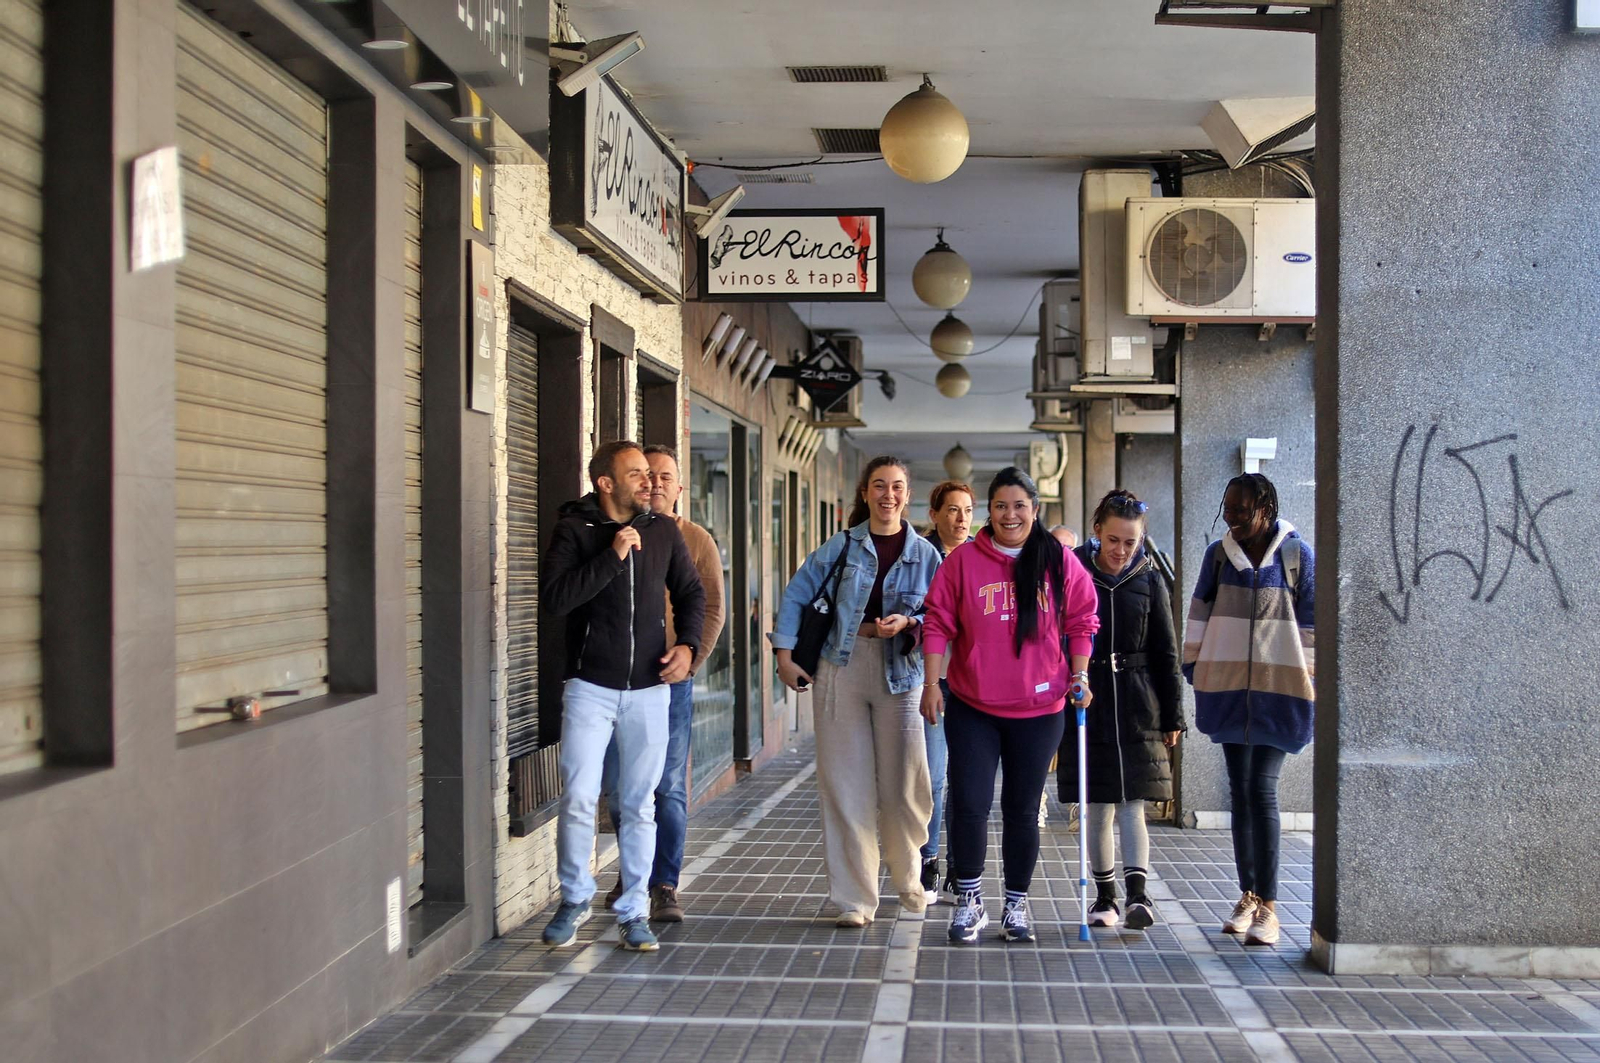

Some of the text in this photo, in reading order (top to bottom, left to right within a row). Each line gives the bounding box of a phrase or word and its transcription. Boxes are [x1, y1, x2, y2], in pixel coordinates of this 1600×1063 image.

[739, 228, 772, 260] El
[718, 268, 869, 287] vinos & tapas
